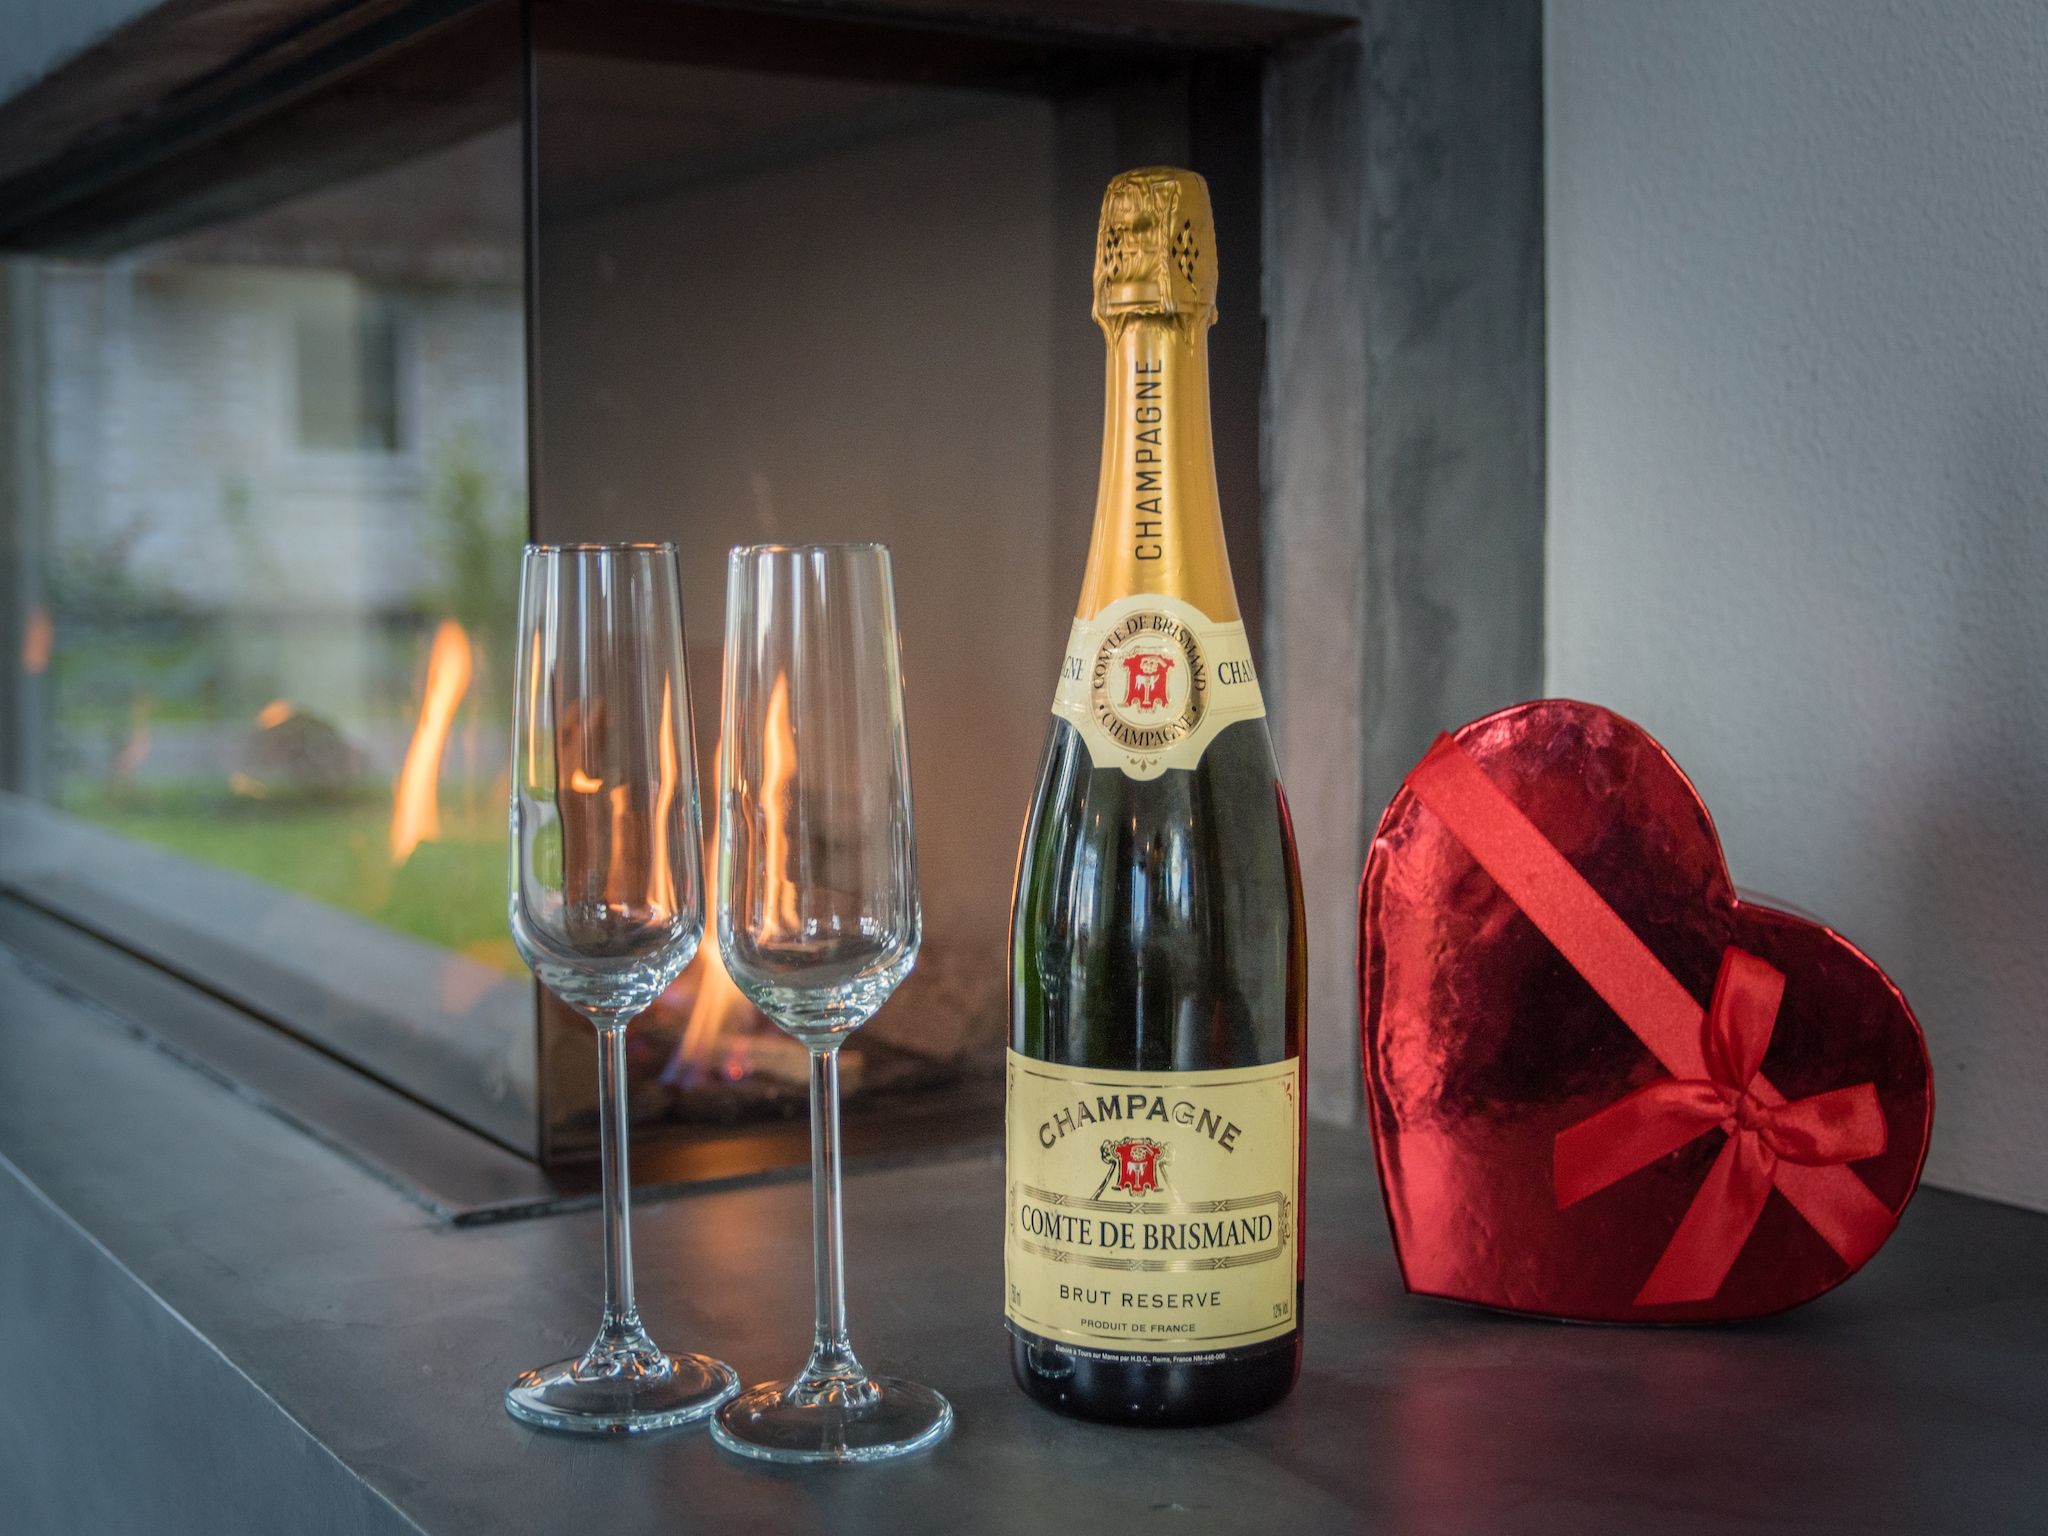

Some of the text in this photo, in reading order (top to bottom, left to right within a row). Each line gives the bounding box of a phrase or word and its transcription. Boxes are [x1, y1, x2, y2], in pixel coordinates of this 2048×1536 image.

[1135, 359, 1162, 560] CHAMPAGNE
[1093, 615, 1207, 692] COMTE DE BRISMAND
[1102, 711, 1197, 747] CHAMPAGNE
[1038, 1094, 1242, 1154] CHAMPAGNE
[1021, 1204, 1273, 1251] COMTE DE BRISMAND
[1060, 1284, 1222, 1308] BRUT RESERVE
[1080, 1318, 1196, 1333] PRODUIT DE FRANCE
[1077, 1348, 1092, 1358] Tours
